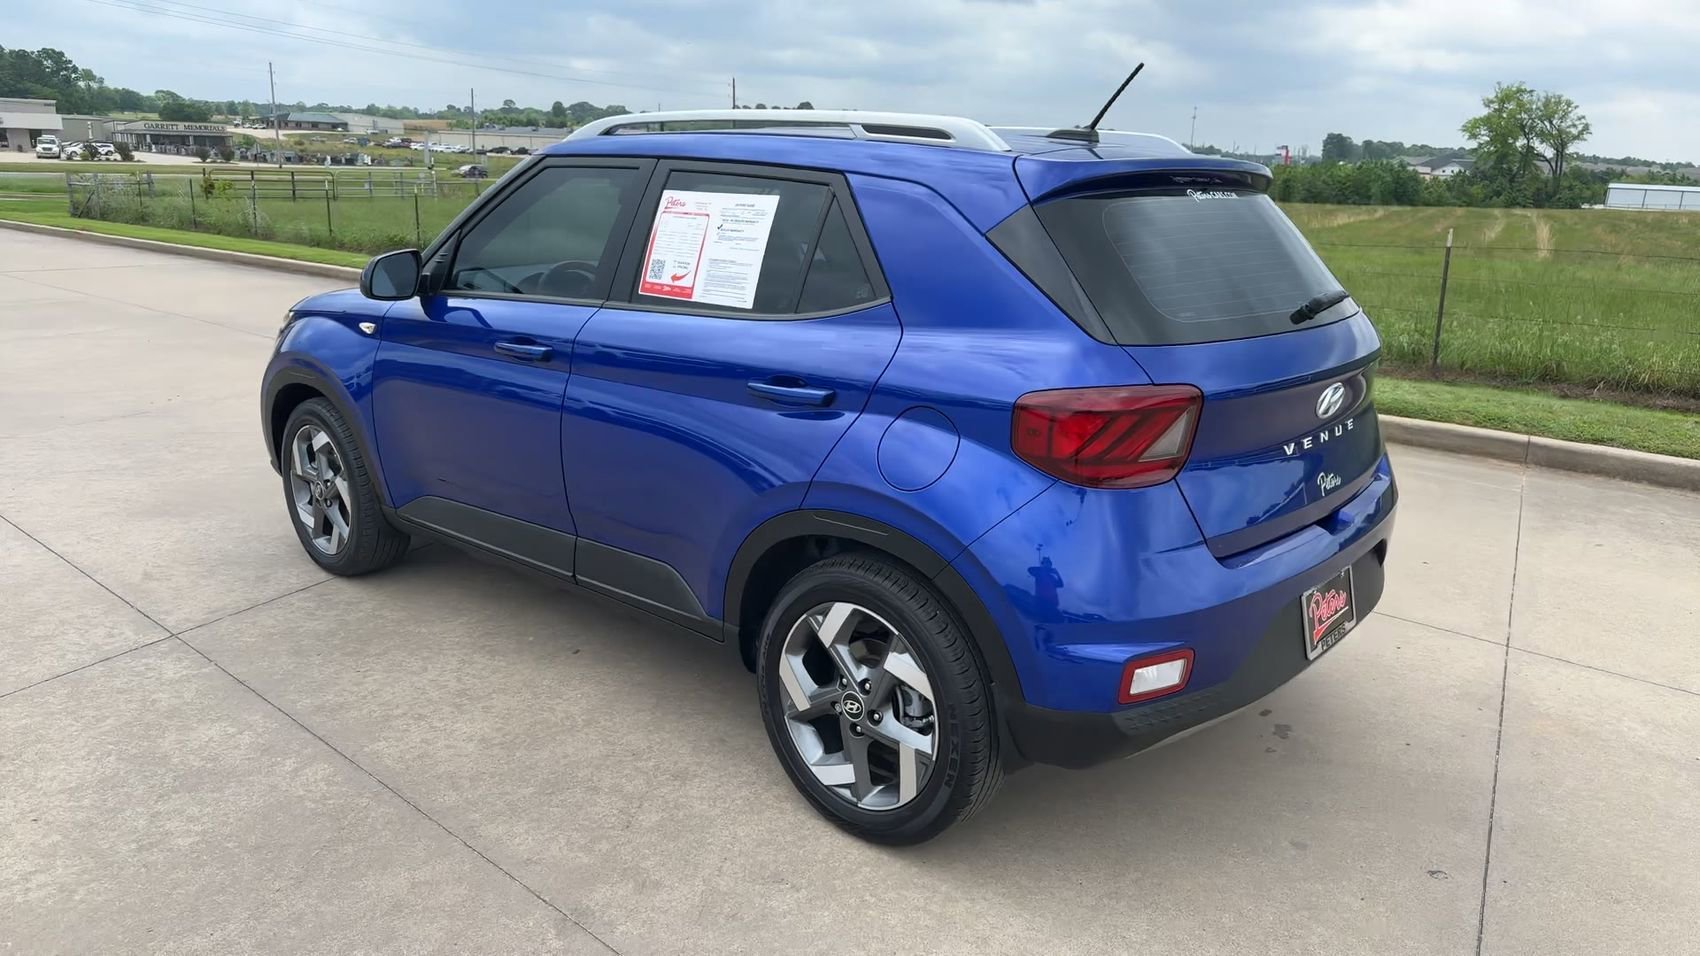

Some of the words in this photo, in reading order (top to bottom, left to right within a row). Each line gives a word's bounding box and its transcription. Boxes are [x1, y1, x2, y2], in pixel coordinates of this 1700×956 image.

[143, 122, 179, 130] GARRETT
[183, 124, 225, 132] MEMORIALS
[664, 196, 686, 208] Peters
[1283, 418, 1354, 455] VENUE
[1317, 472, 1342, 496] Peters
[1308, 588, 1347, 630] Peters
[1320, 623, 1346, 650] PETERS
